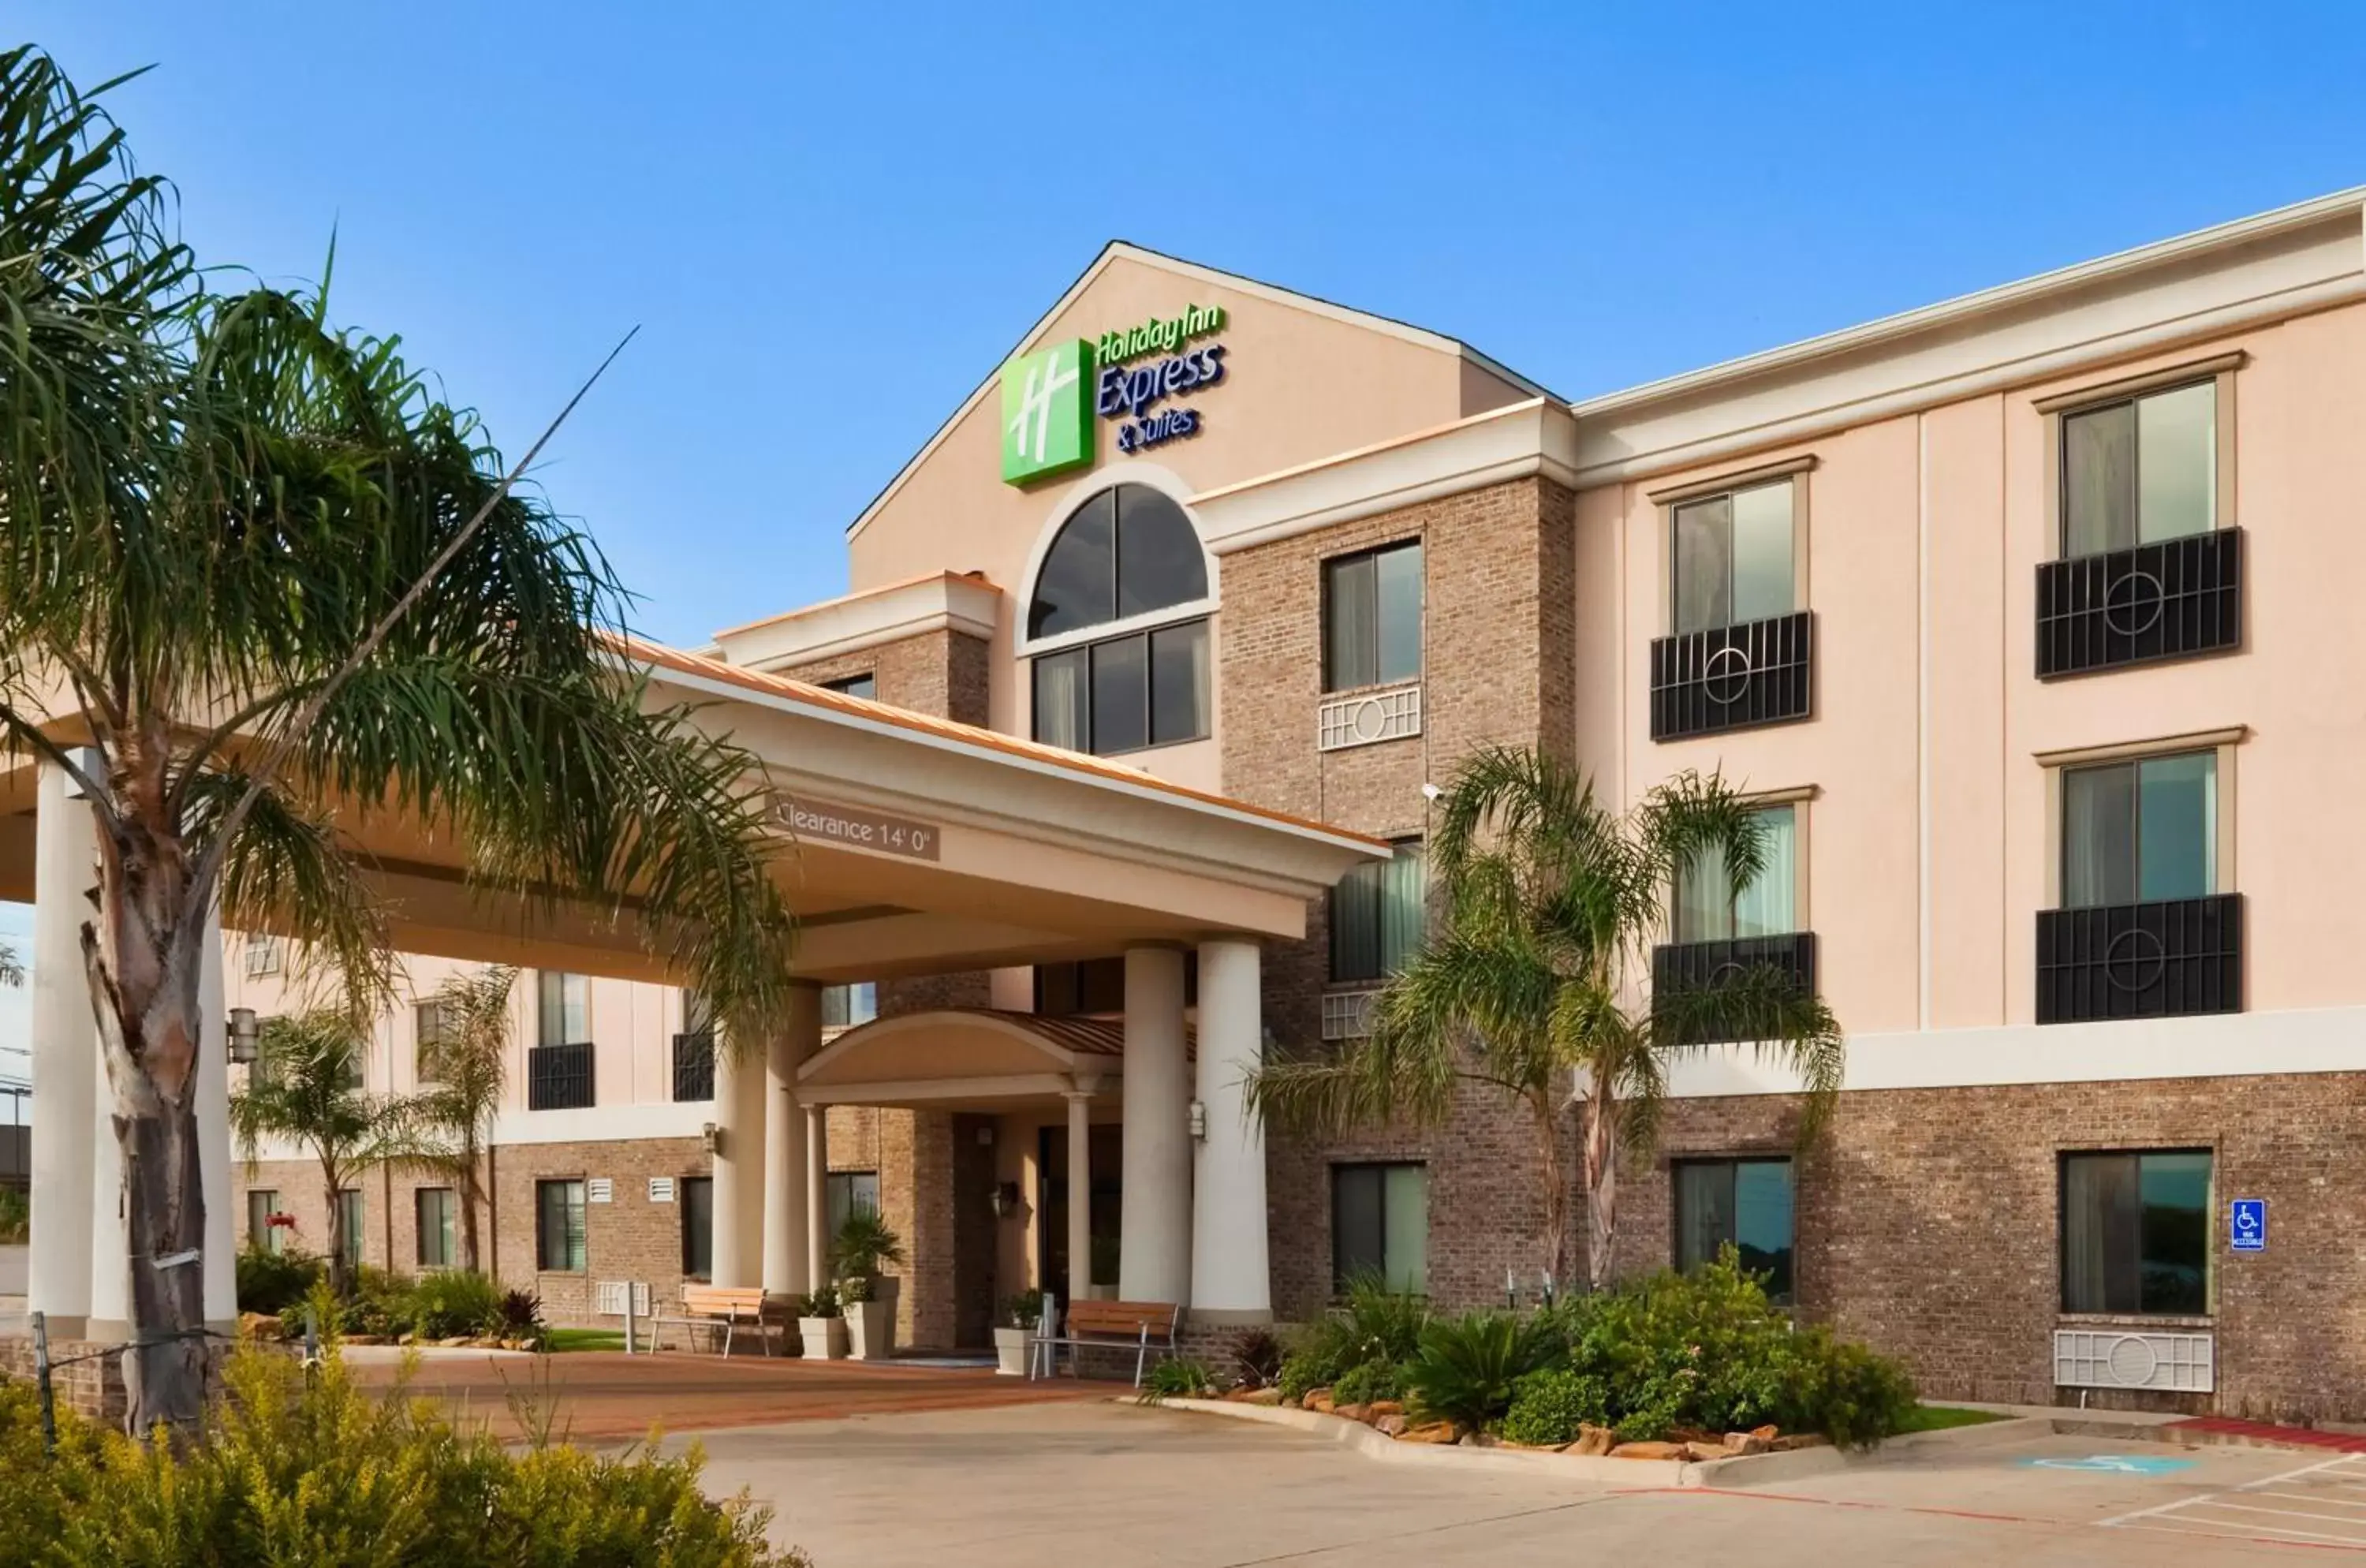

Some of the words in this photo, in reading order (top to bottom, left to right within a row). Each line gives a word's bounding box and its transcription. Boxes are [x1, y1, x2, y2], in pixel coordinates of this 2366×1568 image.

[1095, 317, 1181, 366] Holiday
[1181, 303, 1222, 336] Inn
[1097, 344, 1223, 416] Express
[1116, 424, 1136, 452] &
[1133, 408, 1196, 447] Suites
[776, 803, 873, 842] Clearance
